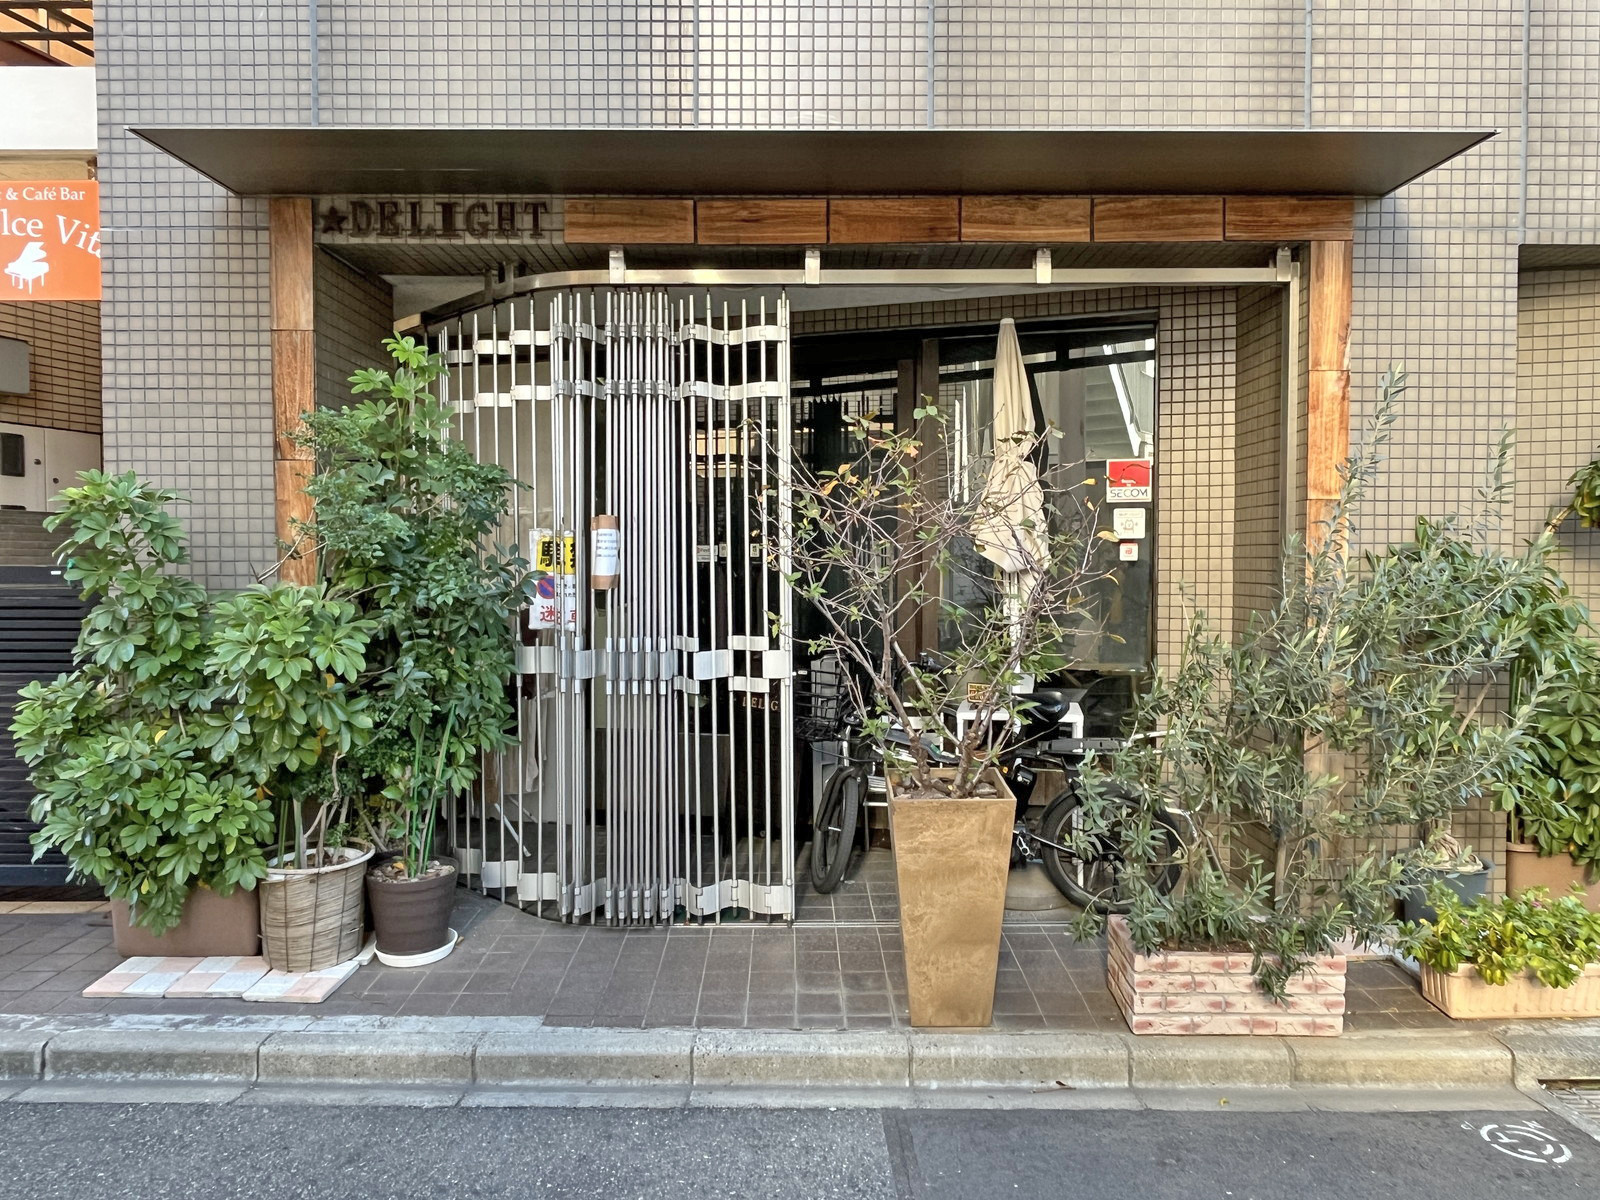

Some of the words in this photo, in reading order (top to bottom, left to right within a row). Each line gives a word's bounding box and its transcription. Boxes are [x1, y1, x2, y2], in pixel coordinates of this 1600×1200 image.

[5, 187, 19, 201] &
[22, 186, 57, 201] Café
[60, 187, 86, 201] Bar
[0, 208, 44, 238] lce
[349, 200, 550, 240] DELIGHT
[1109, 488, 1149, 498] SECOM
